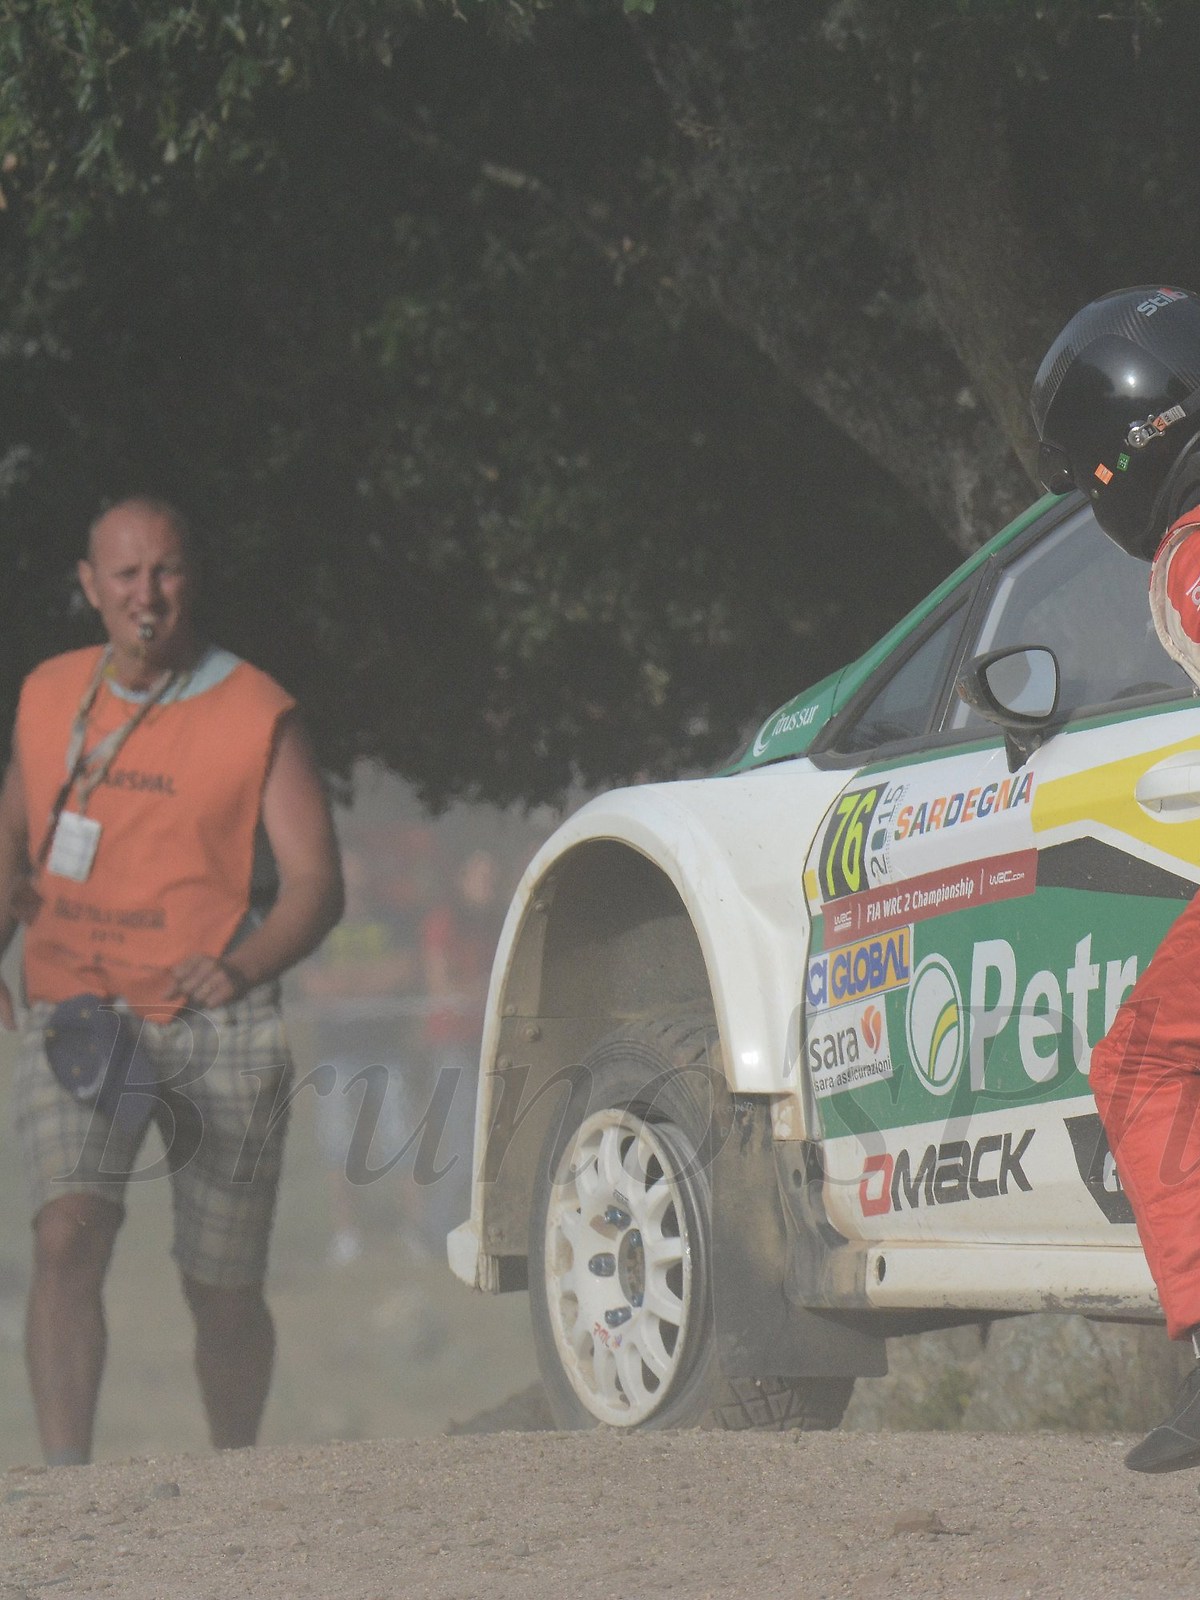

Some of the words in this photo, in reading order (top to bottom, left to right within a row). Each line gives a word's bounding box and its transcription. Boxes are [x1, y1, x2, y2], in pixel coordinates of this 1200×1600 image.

[894, 772, 1034, 841] SARDEGNA
[826, 789, 877, 896] 76
[867, 899, 881, 922] FIA
[883, 894, 902, 917] WRC
[904, 893, 910, 912] 2
[912, 878, 974, 909] Championship
[832, 934, 909, 999] GLOBAL
[809, 1027, 859, 1073] sara
[814, 1078, 834, 1092] sara
